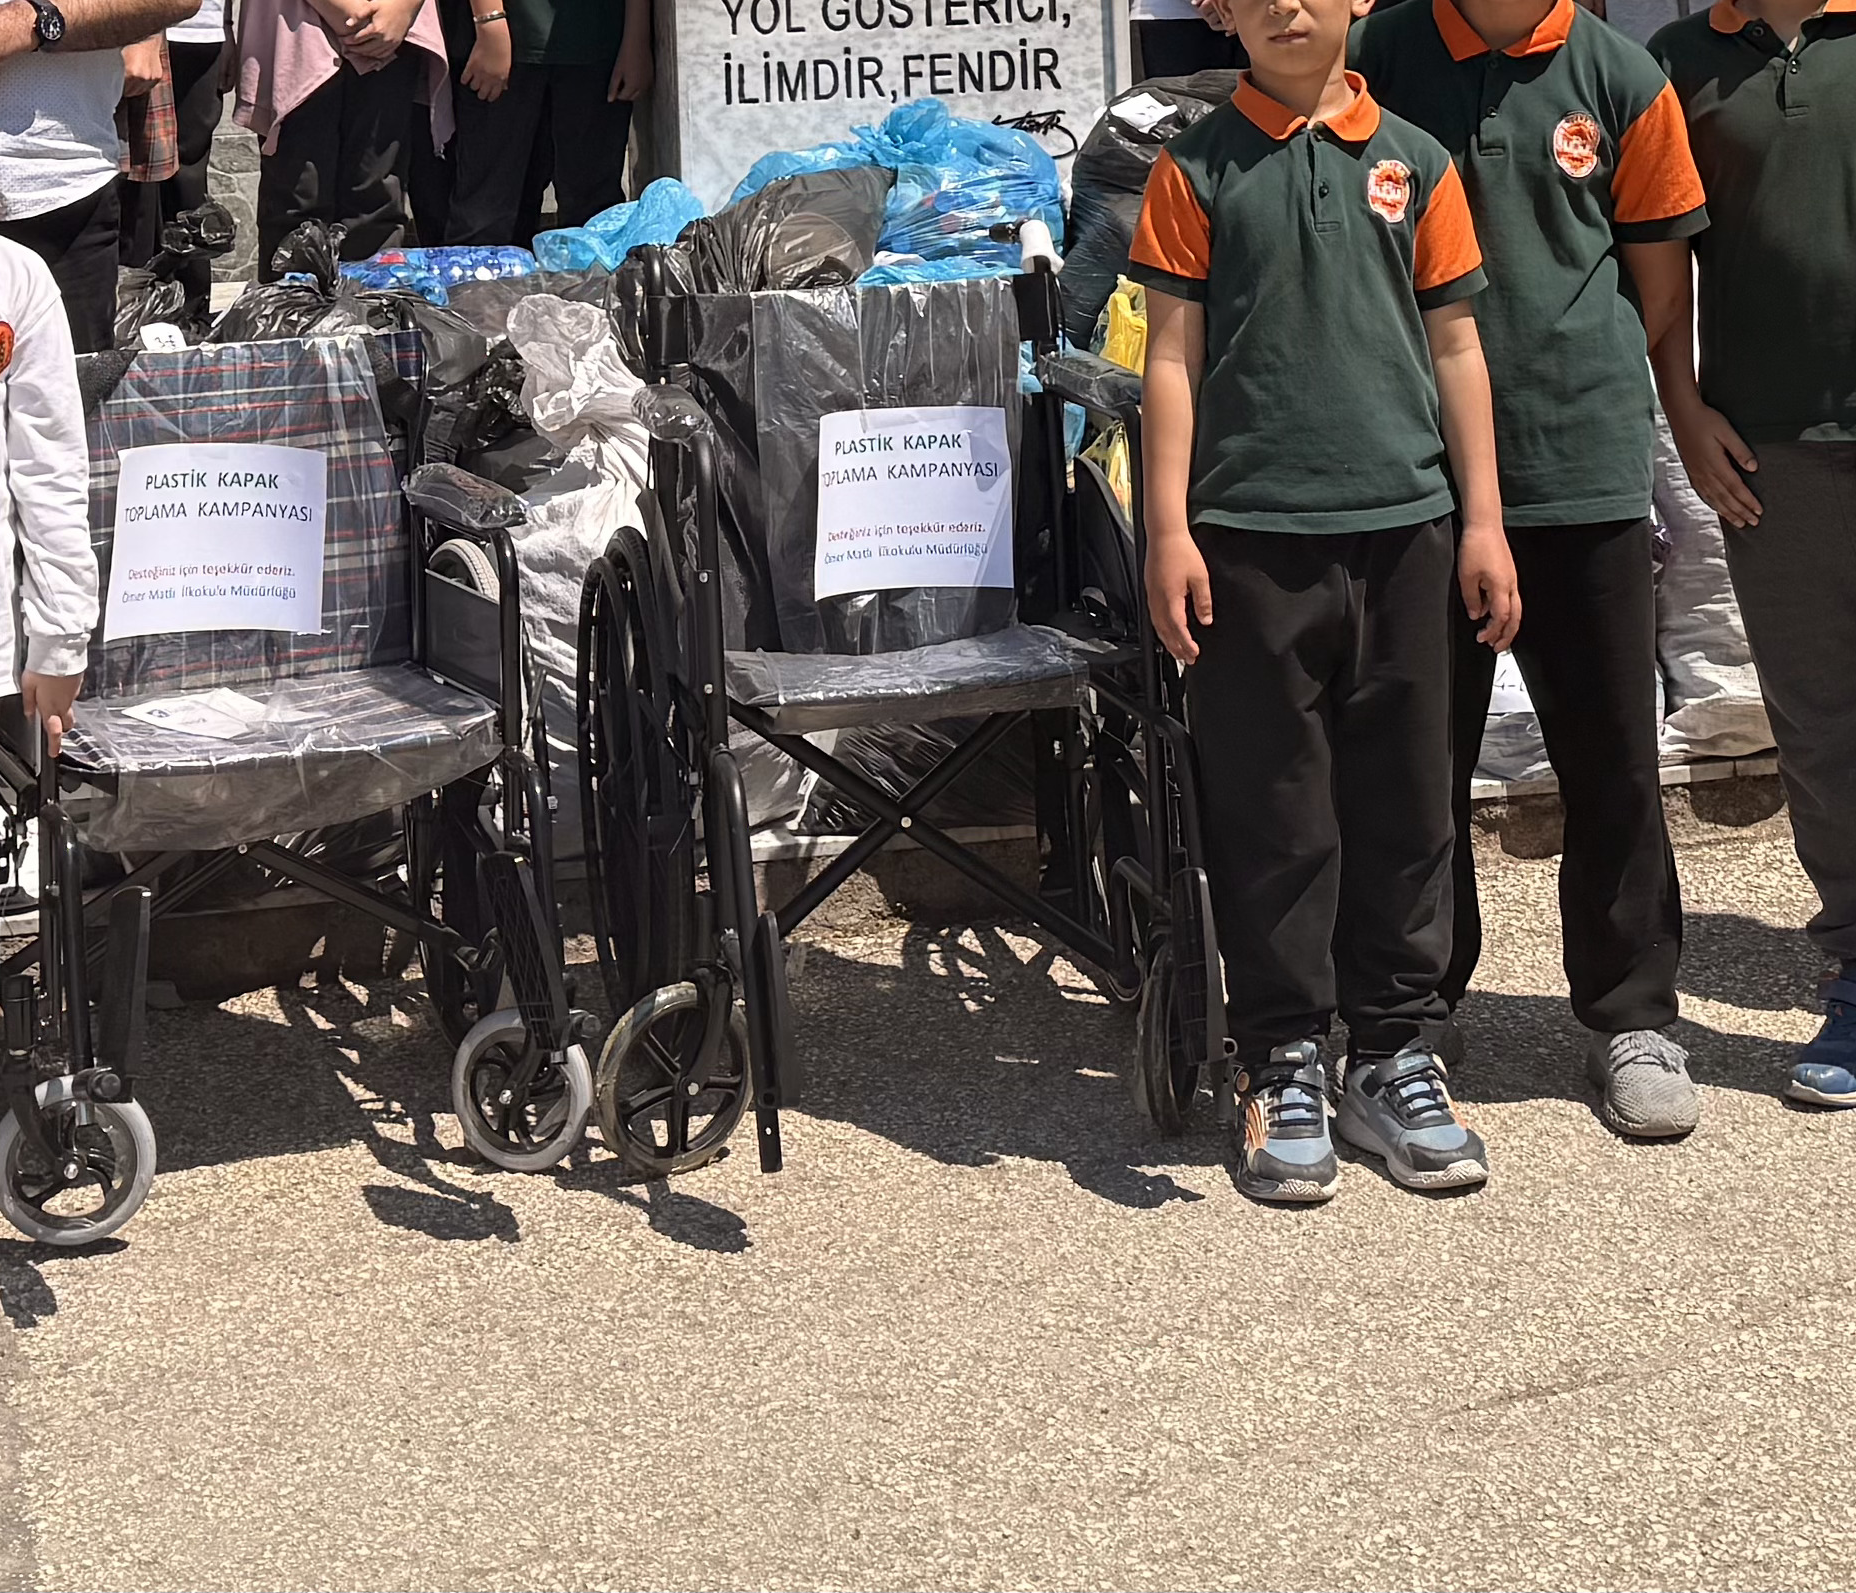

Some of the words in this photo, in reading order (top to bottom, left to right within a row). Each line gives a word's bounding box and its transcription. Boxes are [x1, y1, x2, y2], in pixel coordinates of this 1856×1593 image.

[835, 433, 894, 456] PLASTİK
[903, 433, 962, 450] KAPAK
[145, 469, 207, 490] PLASTİK
[217, 472, 279, 489] KAPAK
[887, 461, 998, 479] KAMPANYASI
[124, 502, 188, 523] TOPLAMA
[198, 502, 313, 522] KAMPANYASI
[202, 562, 253, 577] teşekkür
